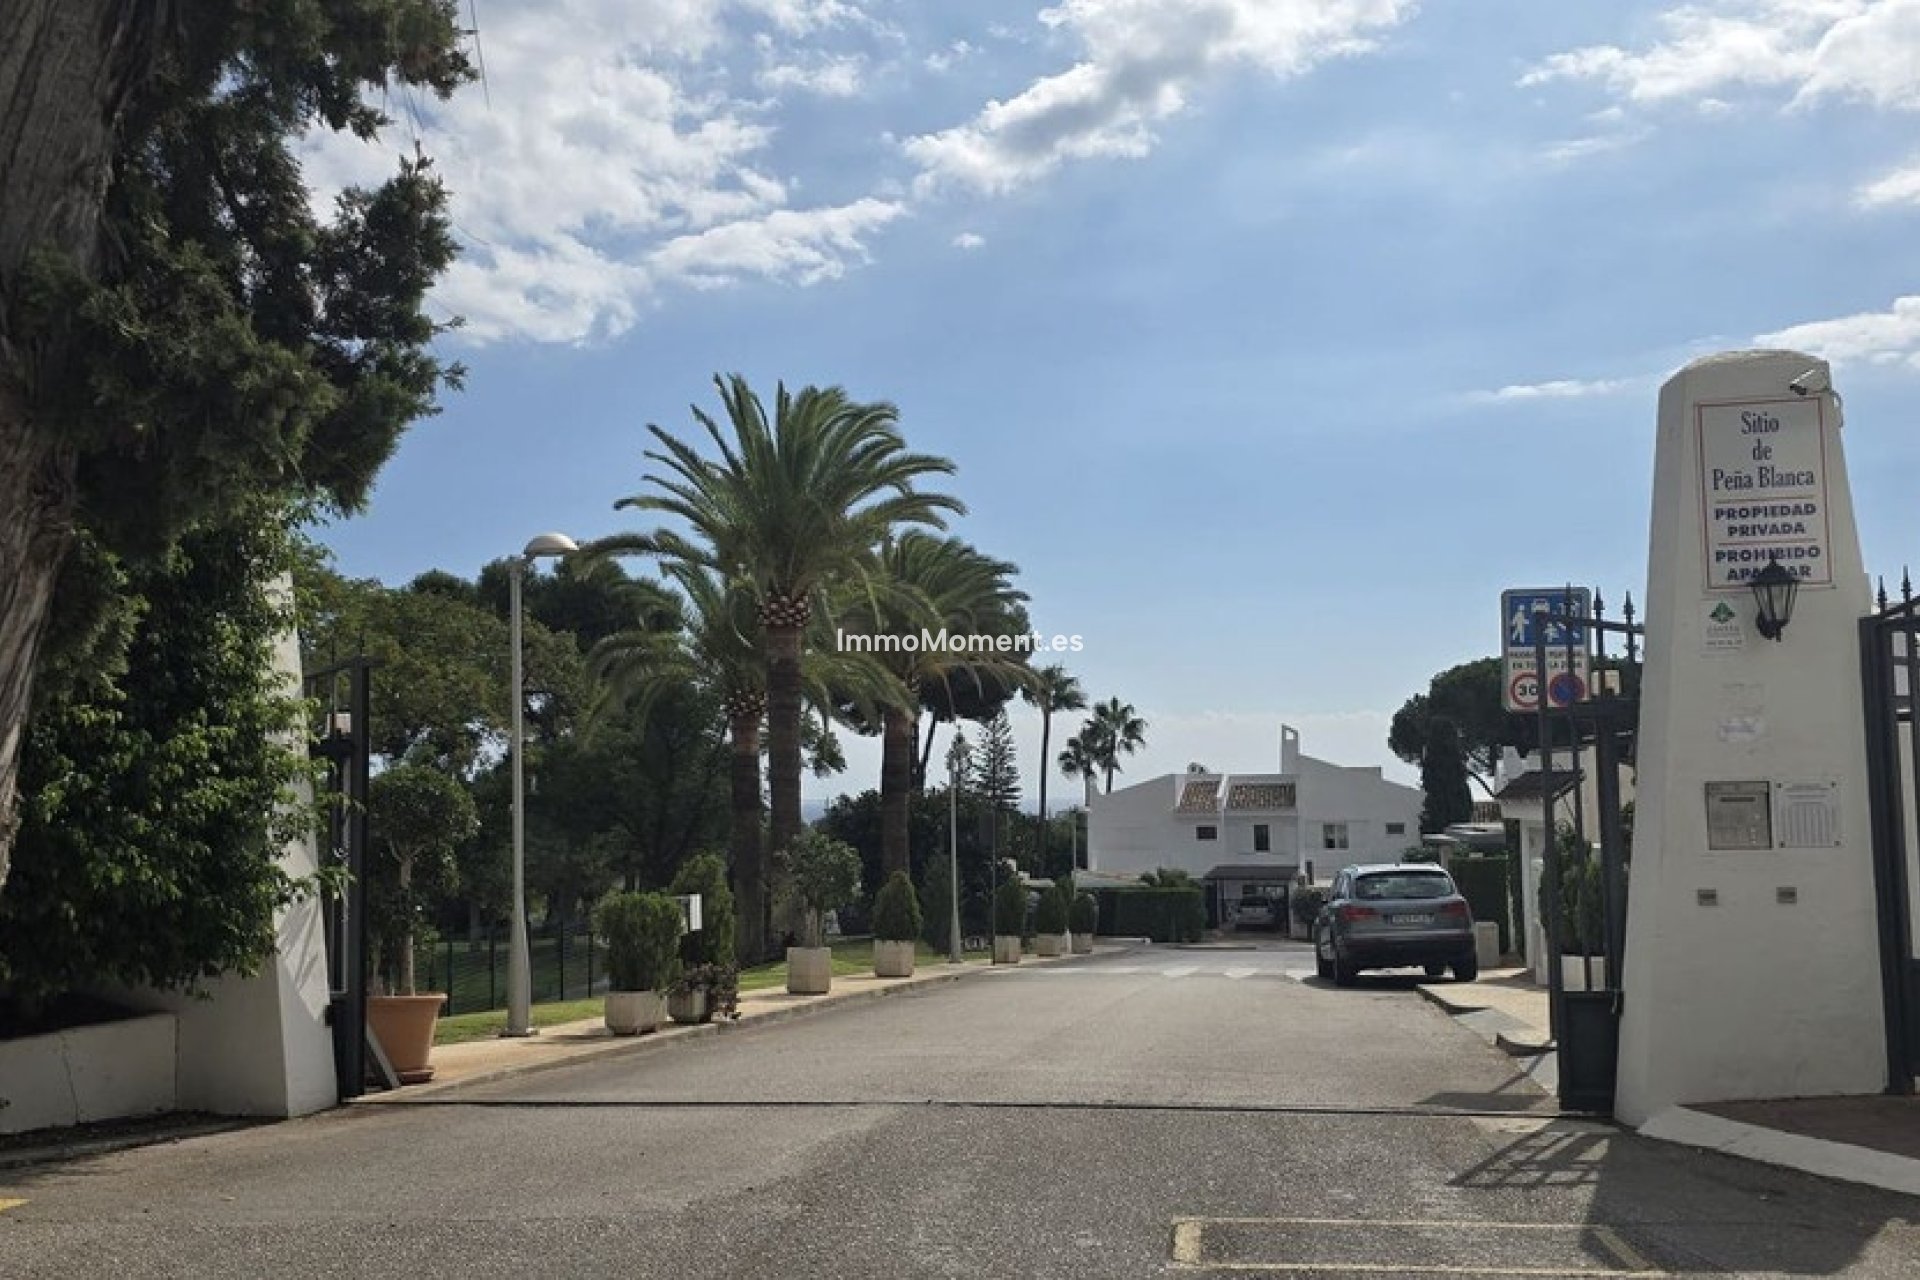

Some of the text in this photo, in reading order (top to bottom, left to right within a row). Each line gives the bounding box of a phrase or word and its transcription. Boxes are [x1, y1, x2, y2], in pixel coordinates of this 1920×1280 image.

[1741, 410, 1780, 434] Sitio
[1752, 438, 1773, 460] de
[1713, 465, 1815, 491] Peña Blanca
[1715, 503, 1816, 520] PROPIEDAD
[1727, 521, 1806, 537] PRIVADA
